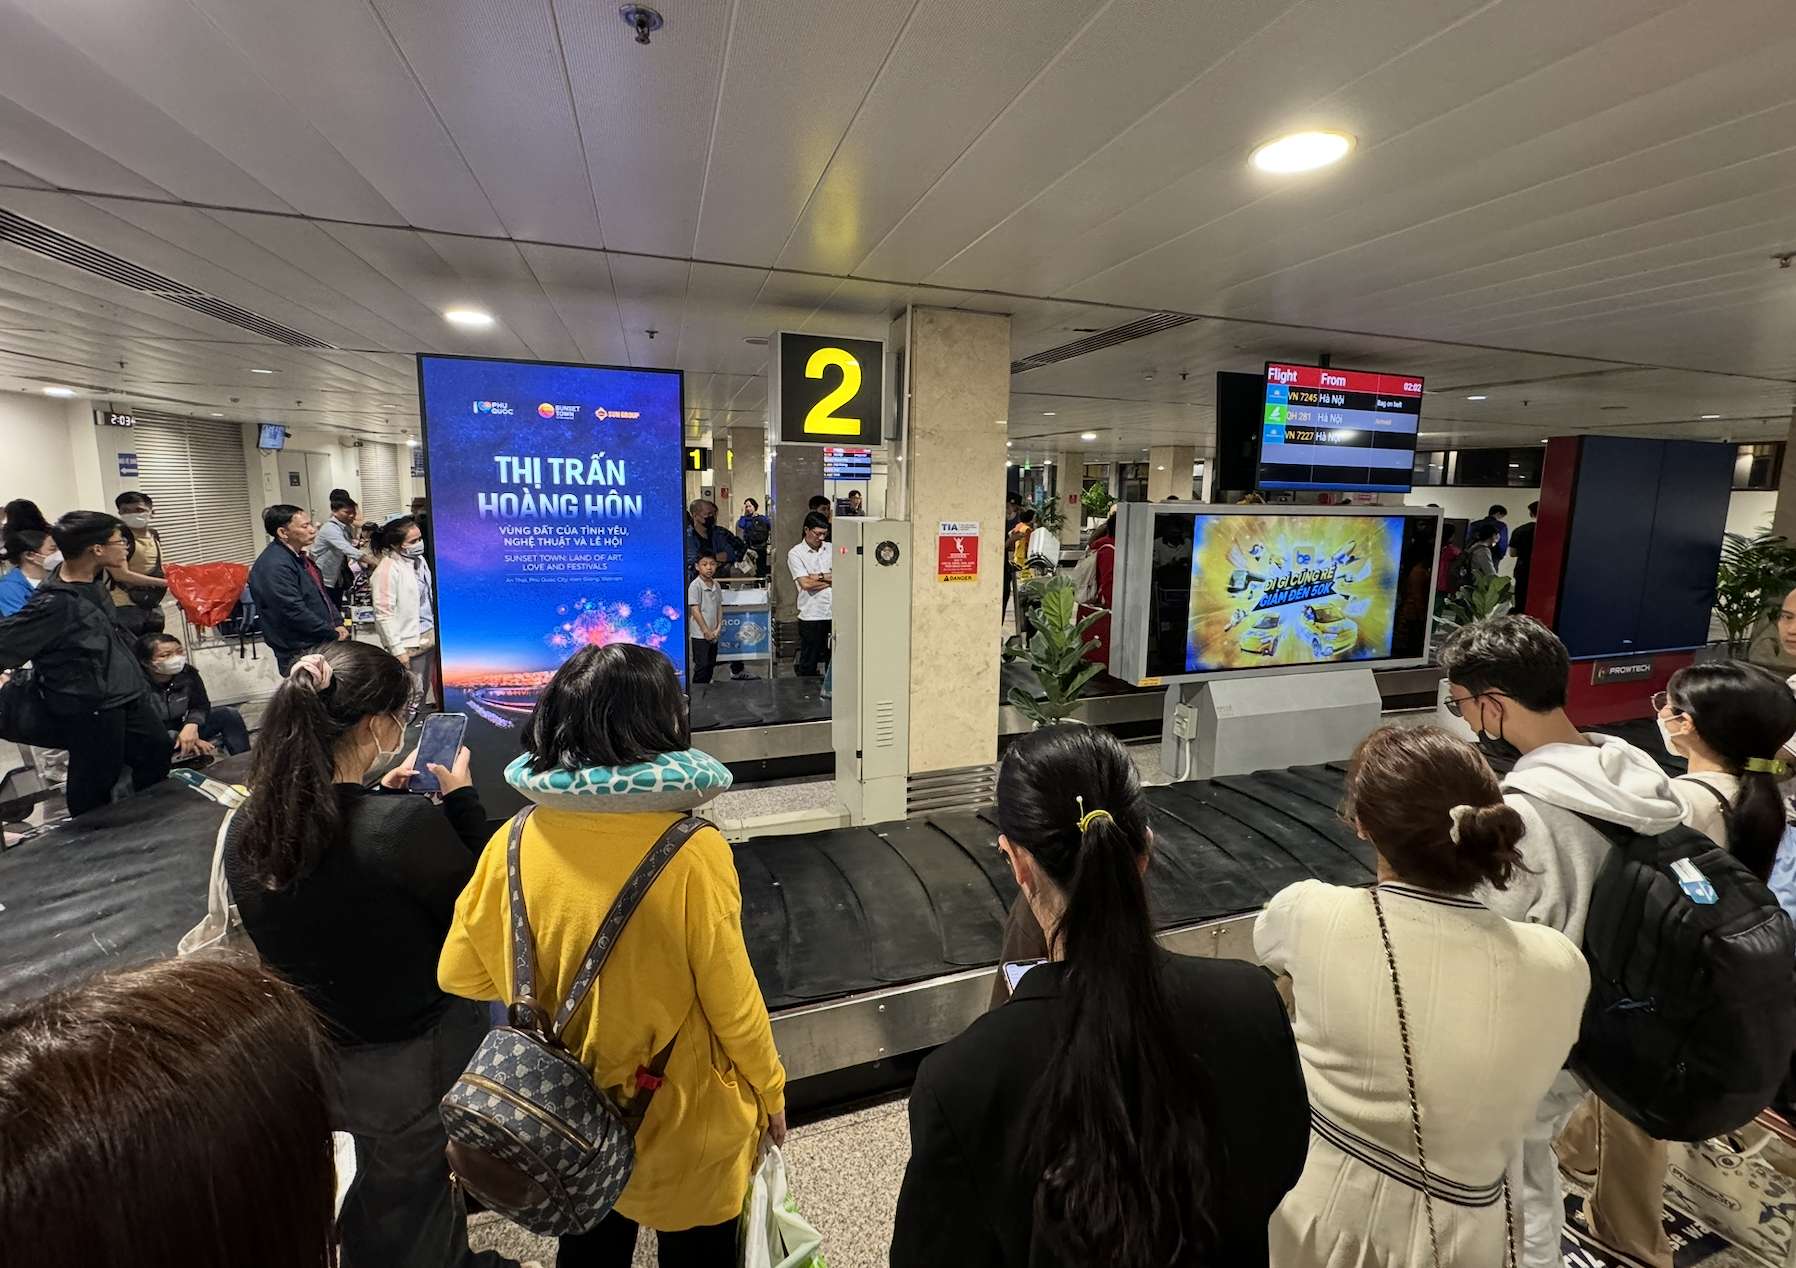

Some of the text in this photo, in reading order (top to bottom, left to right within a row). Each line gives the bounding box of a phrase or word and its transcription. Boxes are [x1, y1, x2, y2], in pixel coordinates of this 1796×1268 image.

[1268, 367, 1422, 392] Flight From 02:02
[803, 347, 863, 437] 2
[1288, 392, 1299, 401] VN
[1300, 393, 1318, 402] 7245
[1320, 393, 1330, 403] Hà
[1331, 394, 1345, 406] Nội
[1377, 400, 1386, 408] Bag
[1393, 400, 1402, 408] belt
[1286, 411, 1298, 420] QH
[1298, 412, 1312, 420] 281
[1318, 412, 1328, 422] Hà
[1330, 413, 1343, 424] Nội
[1284, 431, 1296, 440] VN
[1296, 432, 1314, 440] 7227
[1316, 432, 1326, 442] Hà
[689, 449, 700, 470] 1
[494, 452, 626, 489] THỊ TRẤN
[478, 488, 643, 520] HOÀNG HÔN
[499, 524, 630, 536] VÙNG ĐẤT CỦA TÌNH YÊU,
[504, 537, 535, 548] NGHỆ
[537, 537, 572, 548] THUẬT
[574, 536, 588, 547] VÀ
[604, 537, 623, 548] HỘI
[504, 554, 538, 562] SUNSET
[540, 554, 566, 562] TOWN:
[568, 554, 592, 562] LAND
[594, 554, 606, 562] OF
[1296, 550, 1311, 566] be
[522, 562, 608, 572] LOVE AND FESTIVALS
[1310, 582, 1333, 598] 50K
[1609, 664, 1651, 675] PROWTECH
